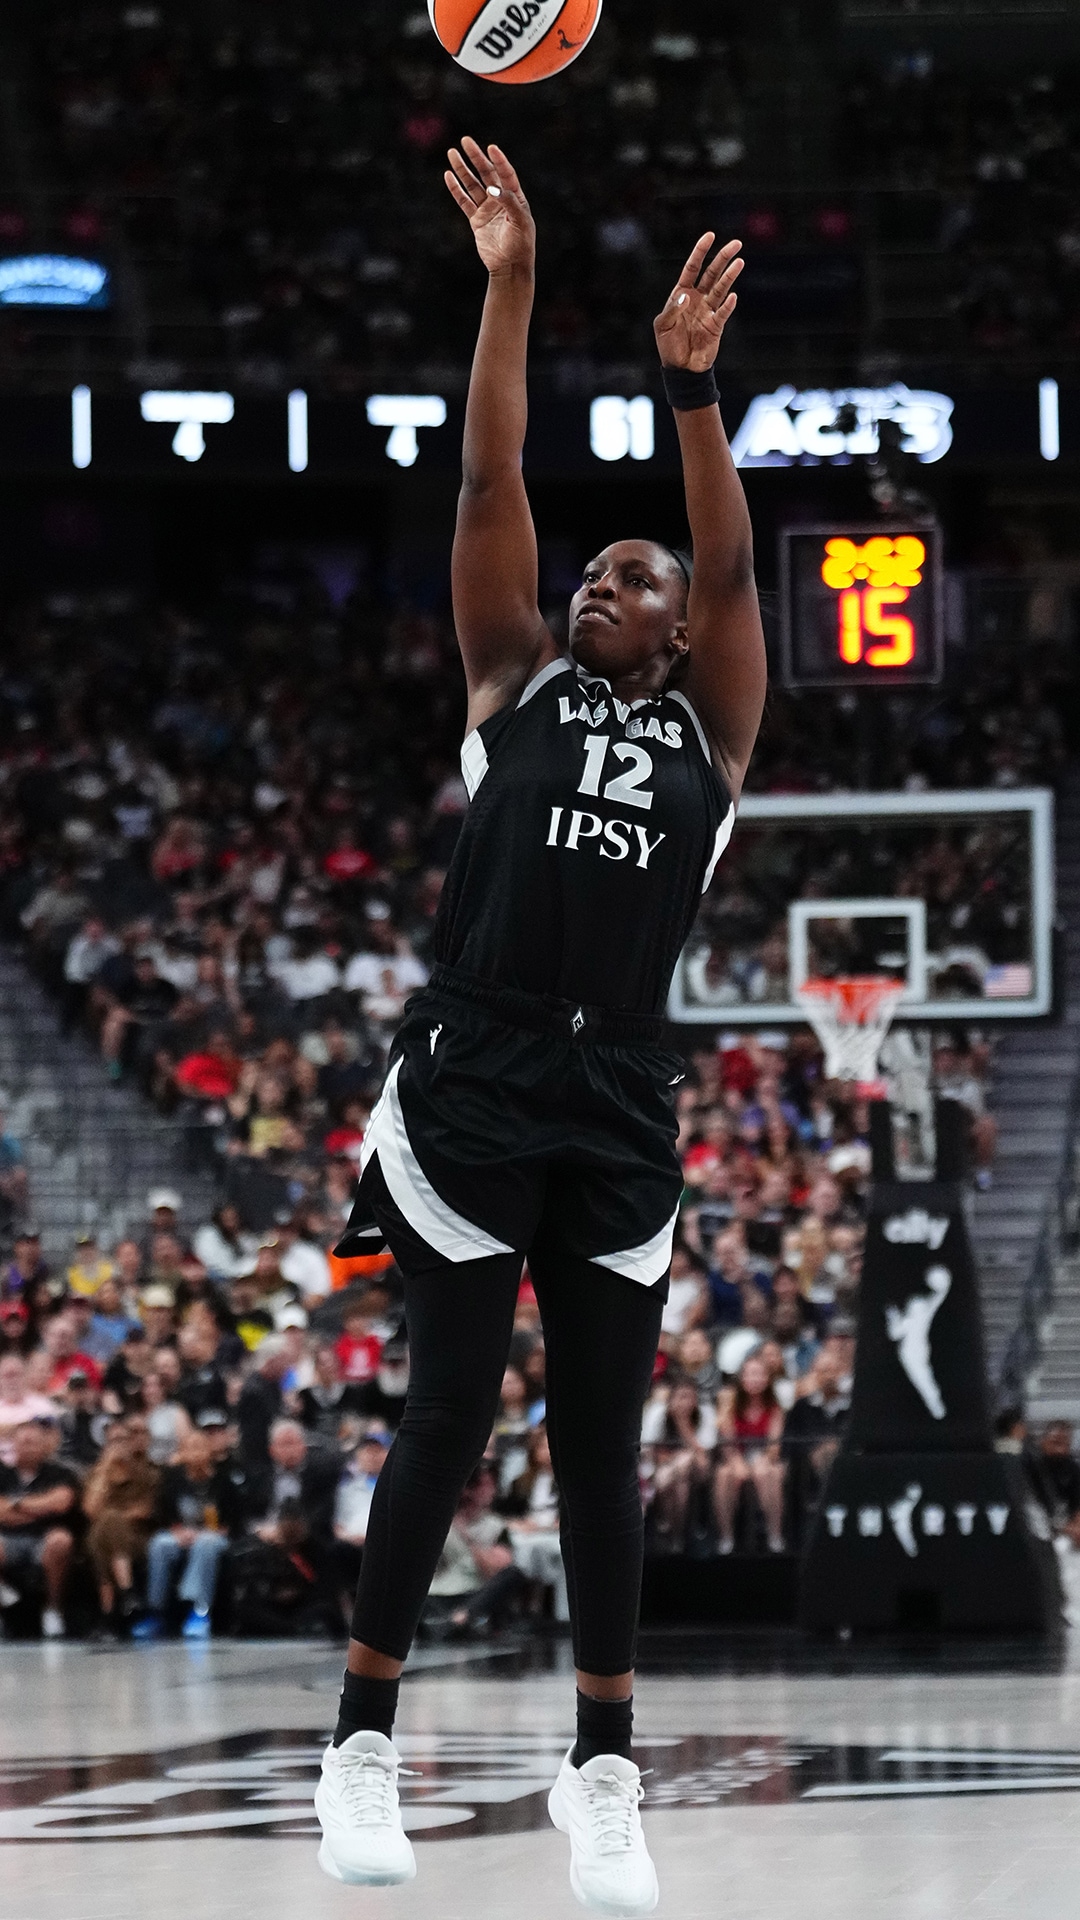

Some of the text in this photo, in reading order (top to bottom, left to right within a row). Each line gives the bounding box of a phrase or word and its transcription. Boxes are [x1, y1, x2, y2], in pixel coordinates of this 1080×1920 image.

[474, 0, 549, 60] Wils
[822, 536, 925, 589] 2:52
[840, 586, 915, 666] 15
[558, 696, 683, 749] LAS VGAS
[577, 734, 654, 810] 12
[546, 807, 666, 870] IPSY
